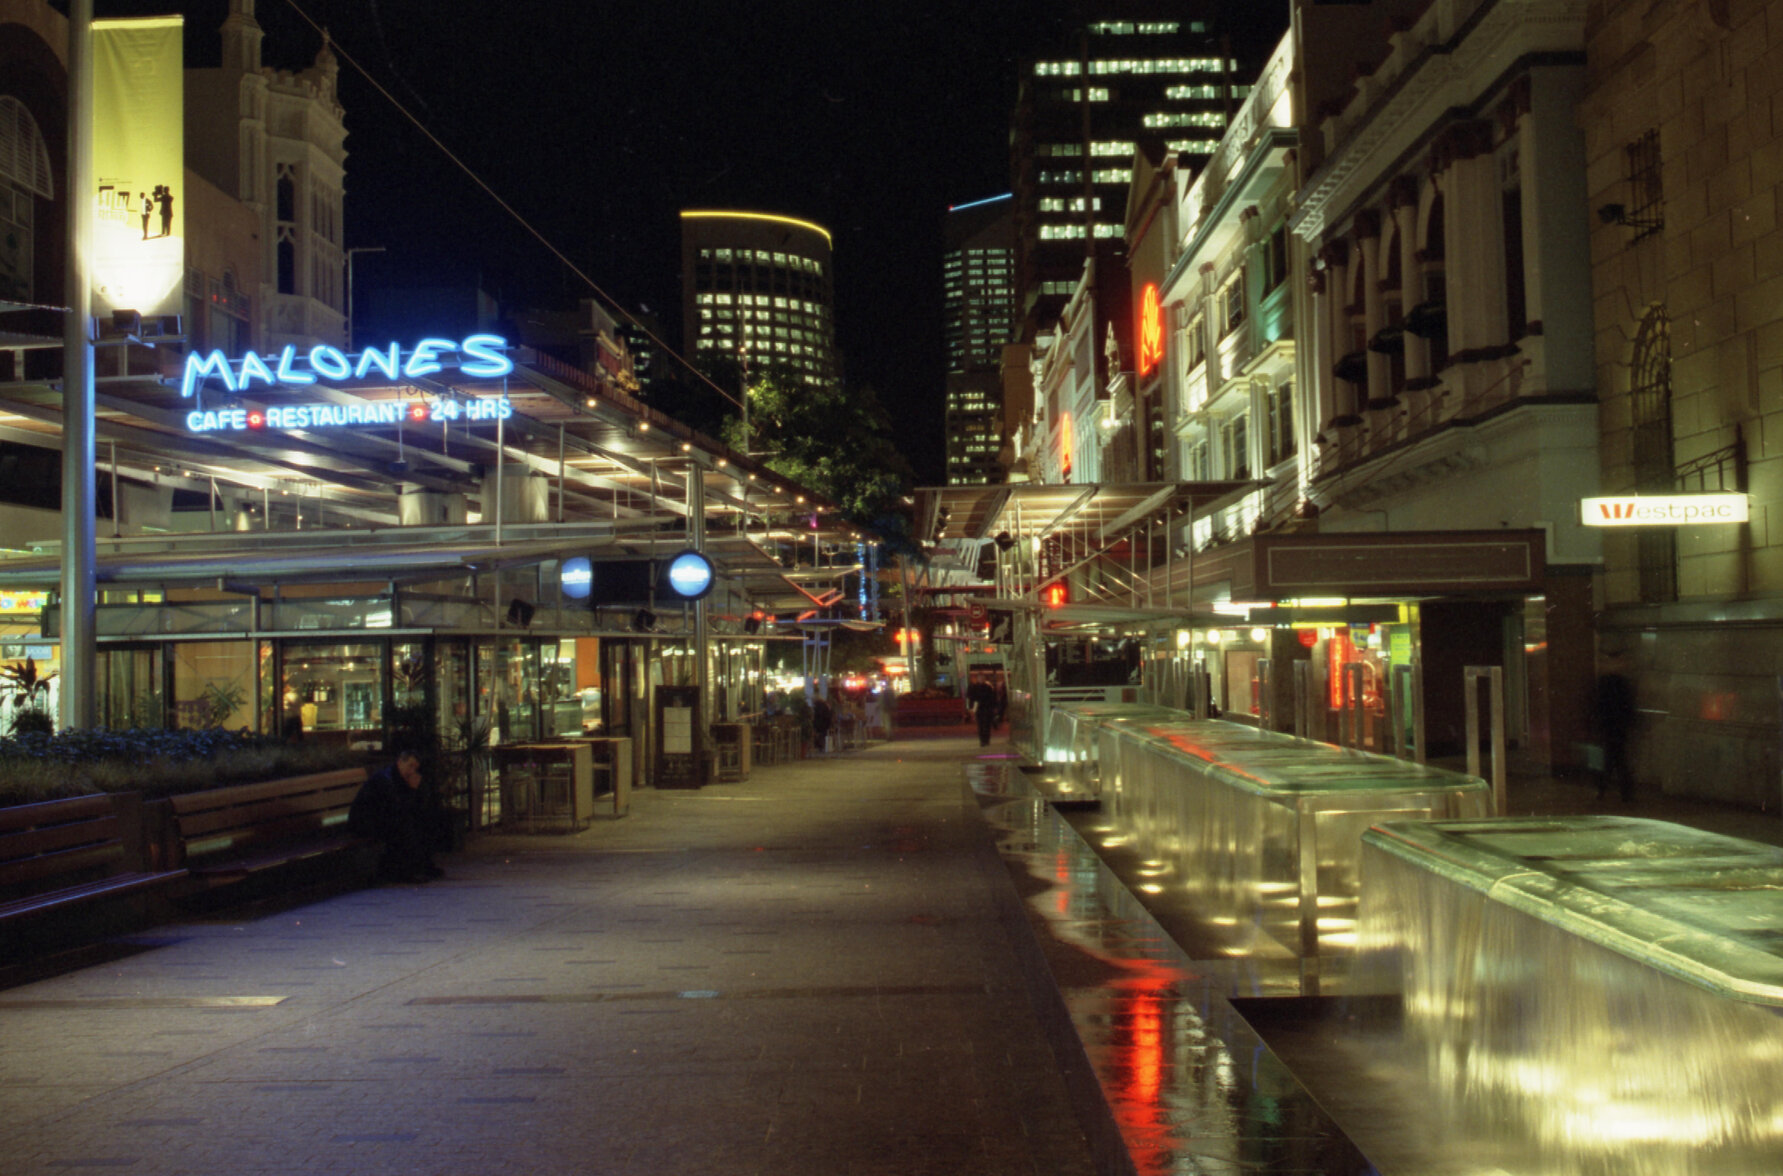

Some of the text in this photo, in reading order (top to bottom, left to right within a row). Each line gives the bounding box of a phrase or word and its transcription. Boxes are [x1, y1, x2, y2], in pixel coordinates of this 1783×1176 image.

[182, 334, 514, 398] MALONES
[187, 399, 512, 431] CAFE RESTAURANT 24 HRS
[1599, 502, 1733, 523] Westpac
